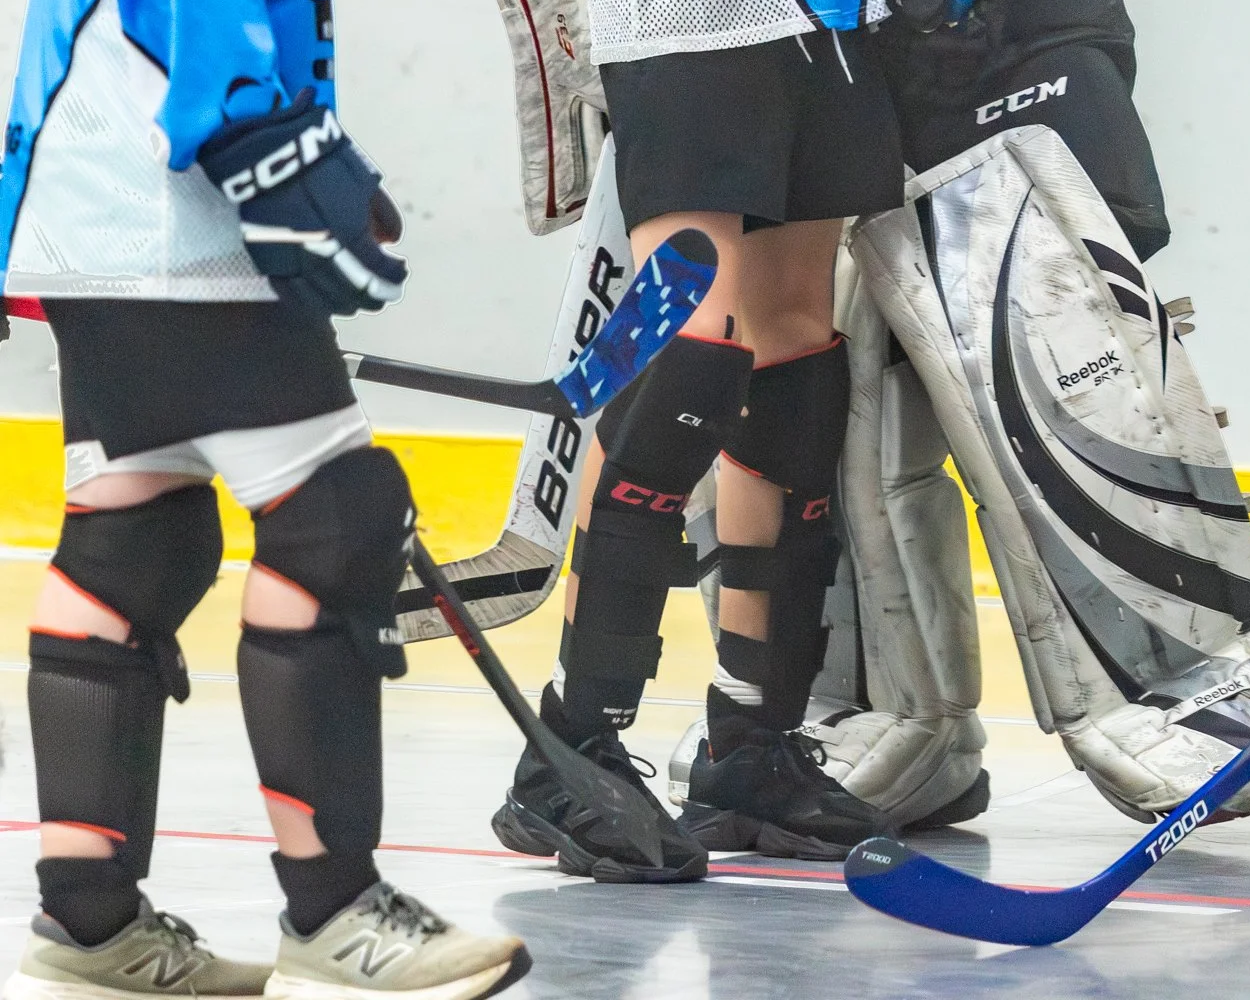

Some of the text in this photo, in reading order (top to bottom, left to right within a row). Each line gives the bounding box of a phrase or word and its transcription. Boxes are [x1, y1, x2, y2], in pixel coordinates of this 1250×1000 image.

[974, 76, 1068, 125] CCM
[222, 109, 343, 203] CCM
[1057, 350, 1120, 391] Reebok
[1193, 678, 1245, 708] Reebok
[1144, 799, 1209, 864] T2000
